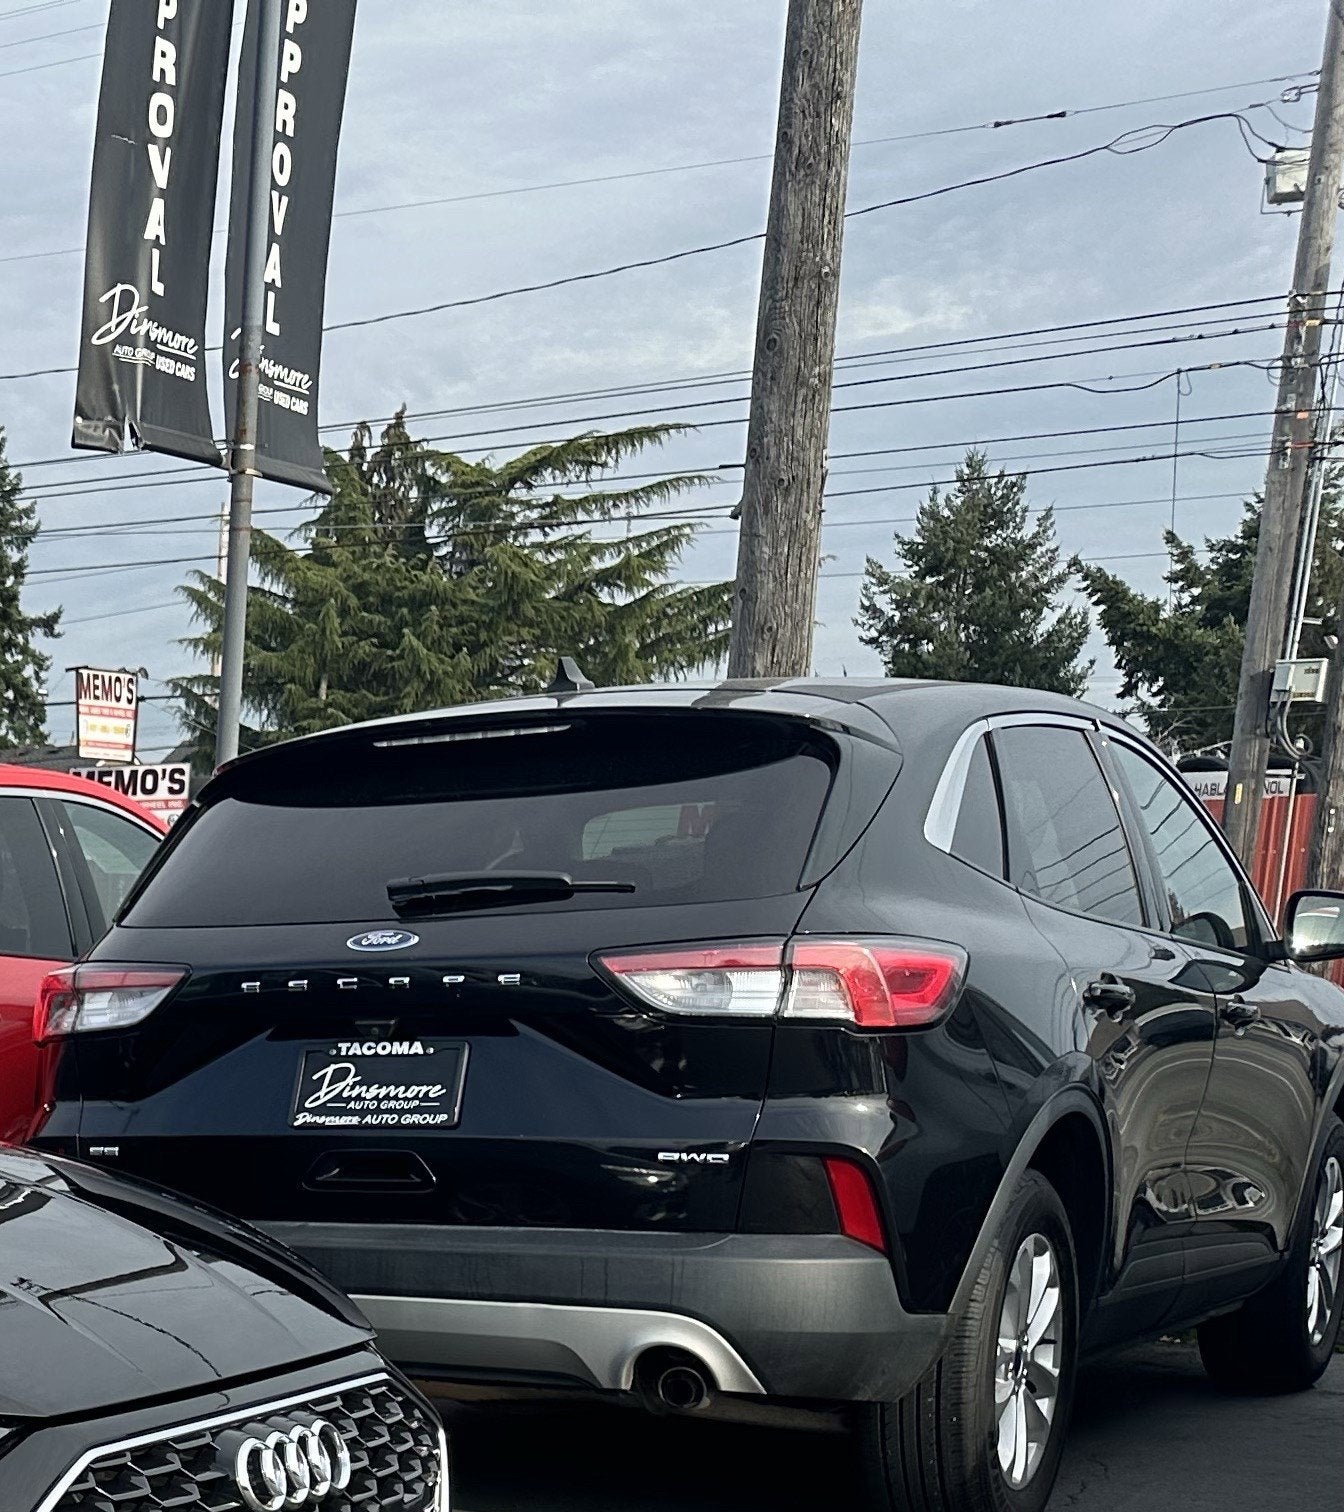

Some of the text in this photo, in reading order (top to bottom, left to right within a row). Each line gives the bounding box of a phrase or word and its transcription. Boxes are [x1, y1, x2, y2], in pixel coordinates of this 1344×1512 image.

[91, 283, 198, 356] Dinsmore
[78, 672, 134, 704] MEMO'S
[71, 768, 186, 796] EMO'S
[1194, 782, 1226, 796] HABL
[362, 931, 404, 946] Ford
[338, 1041, 424, 1056] TACOMA
[305, 1062, 447, 1108] Dinsmore
[347, 1100, 419, 1110] AUTO GROUP
[293, 1112, 448, 1126] Dinsmore AUTO GROUP
